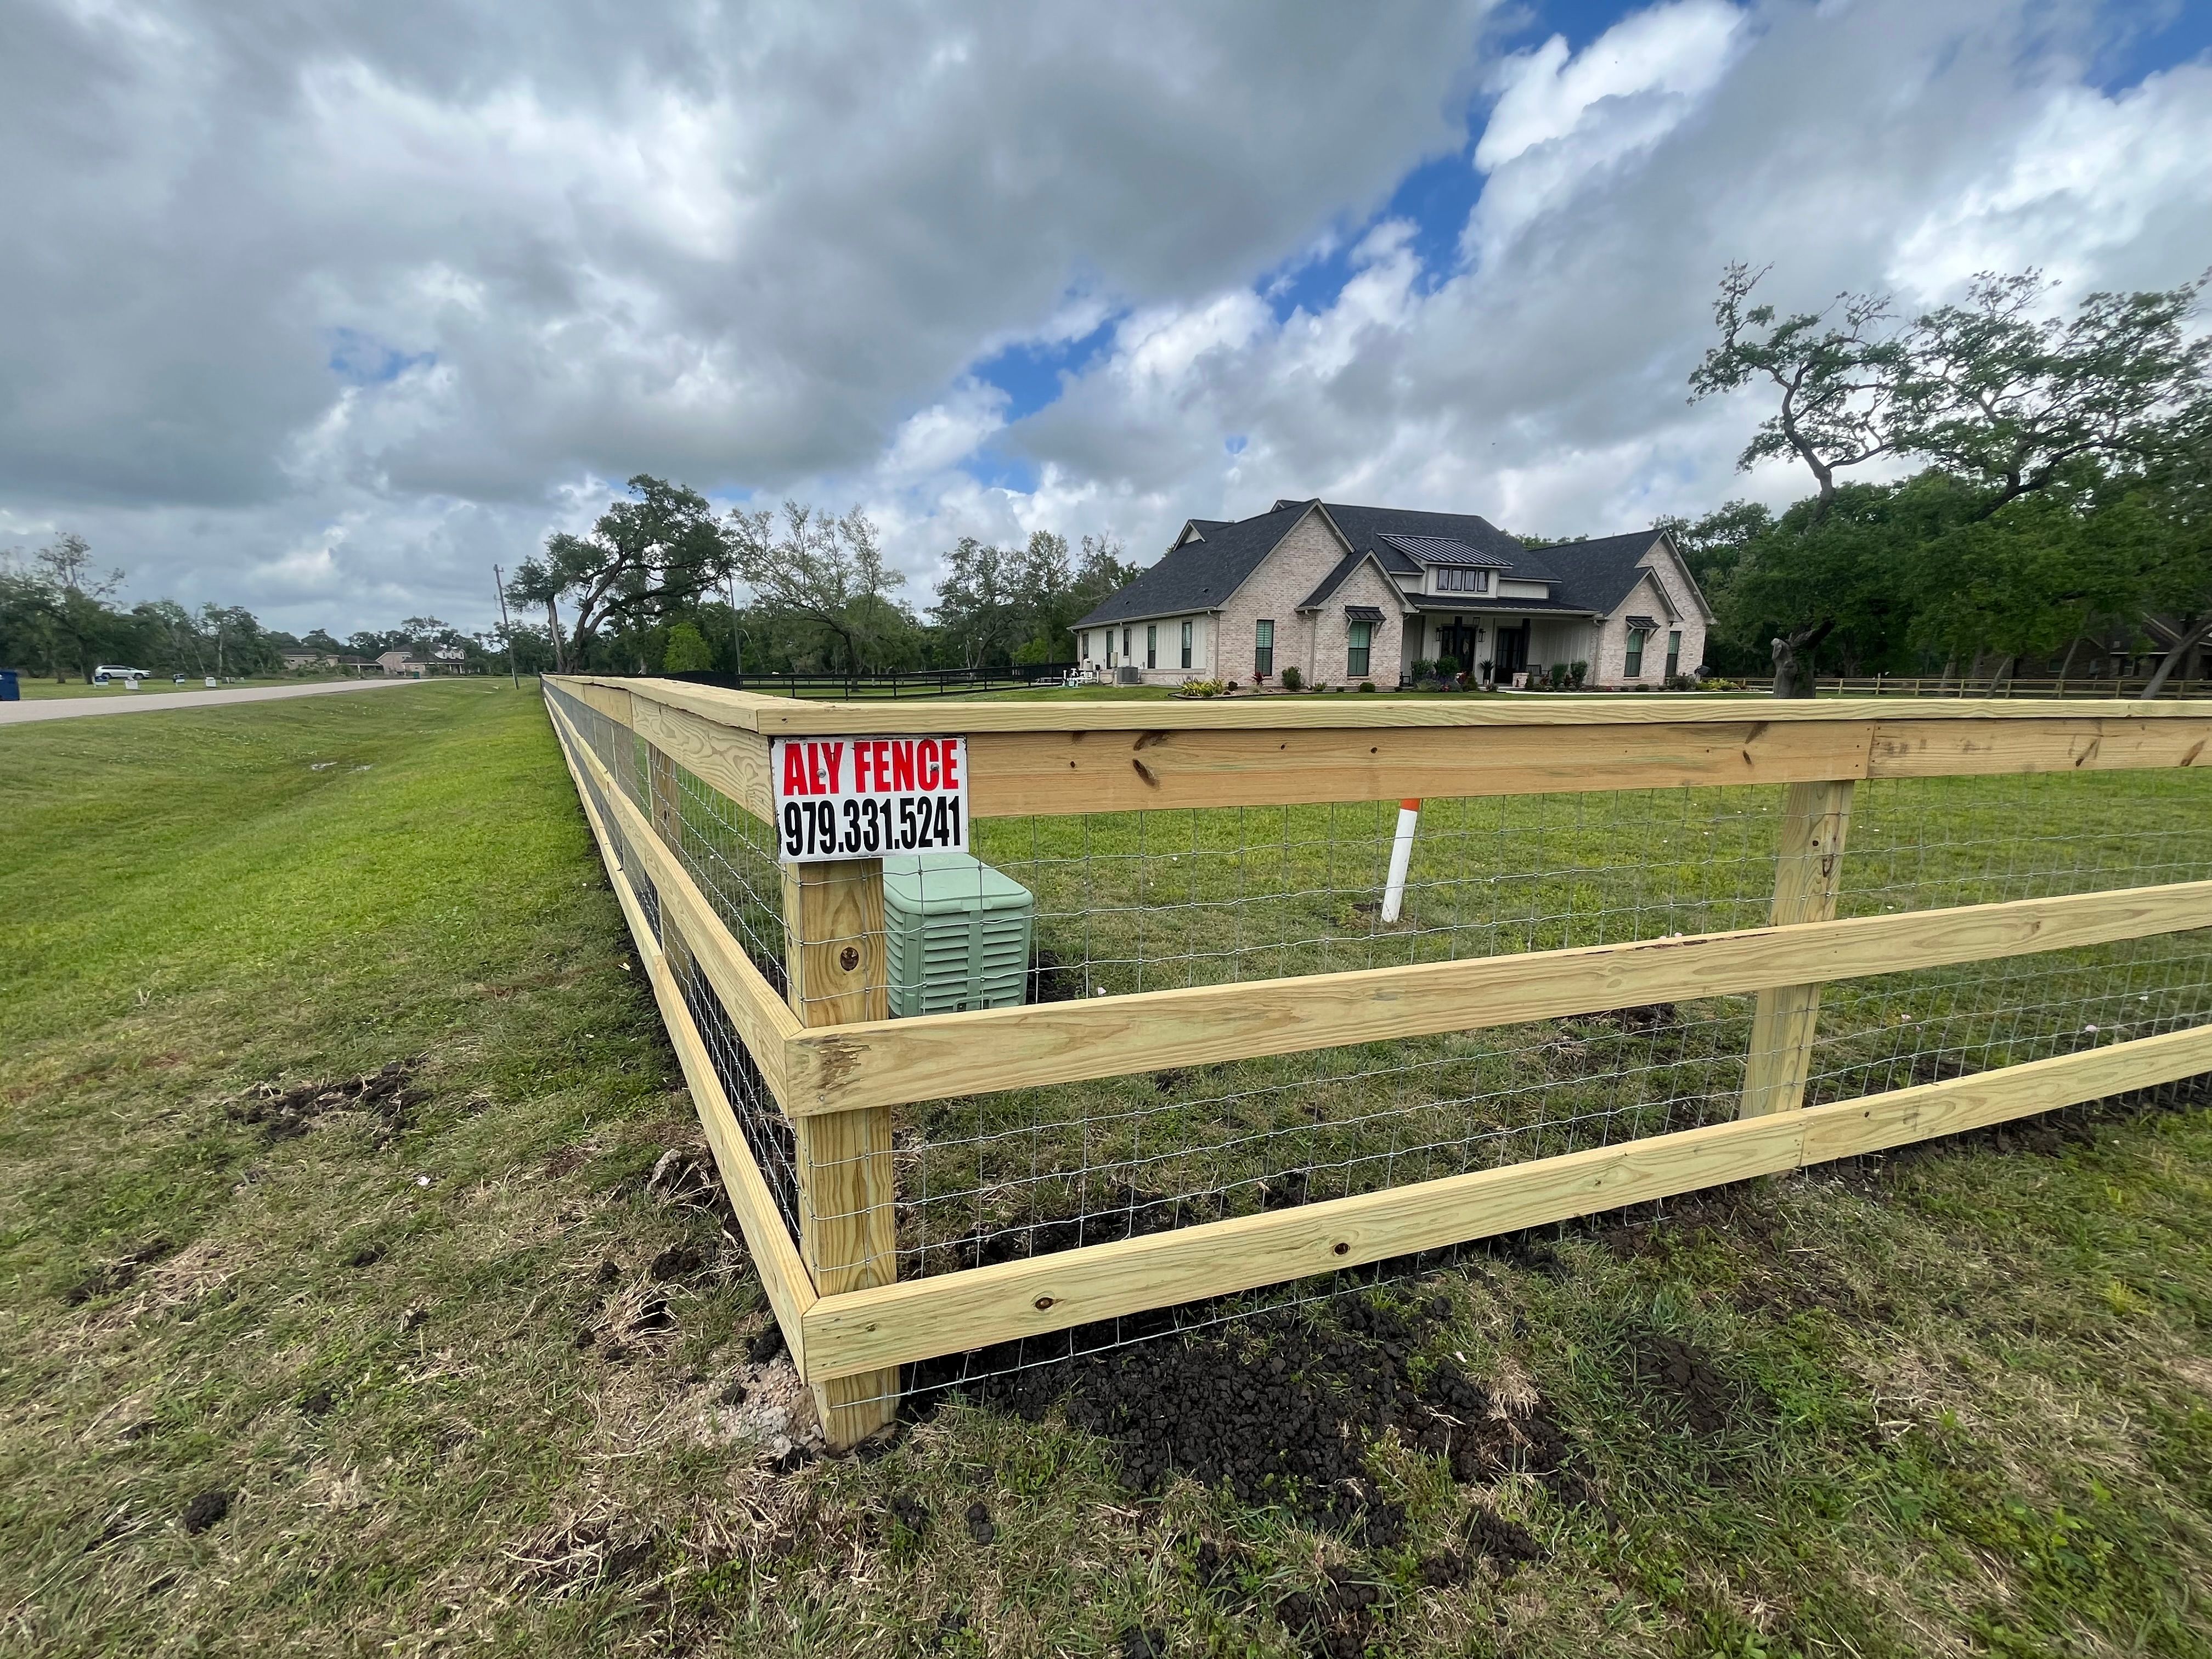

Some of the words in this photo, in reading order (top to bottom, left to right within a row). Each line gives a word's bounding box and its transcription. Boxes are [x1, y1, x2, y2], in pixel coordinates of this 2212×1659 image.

[783, 742, 844, 795] ALY
[854, 739, 959, 793] FENCE
[784, 795, 961, 856] 979.331.5241
